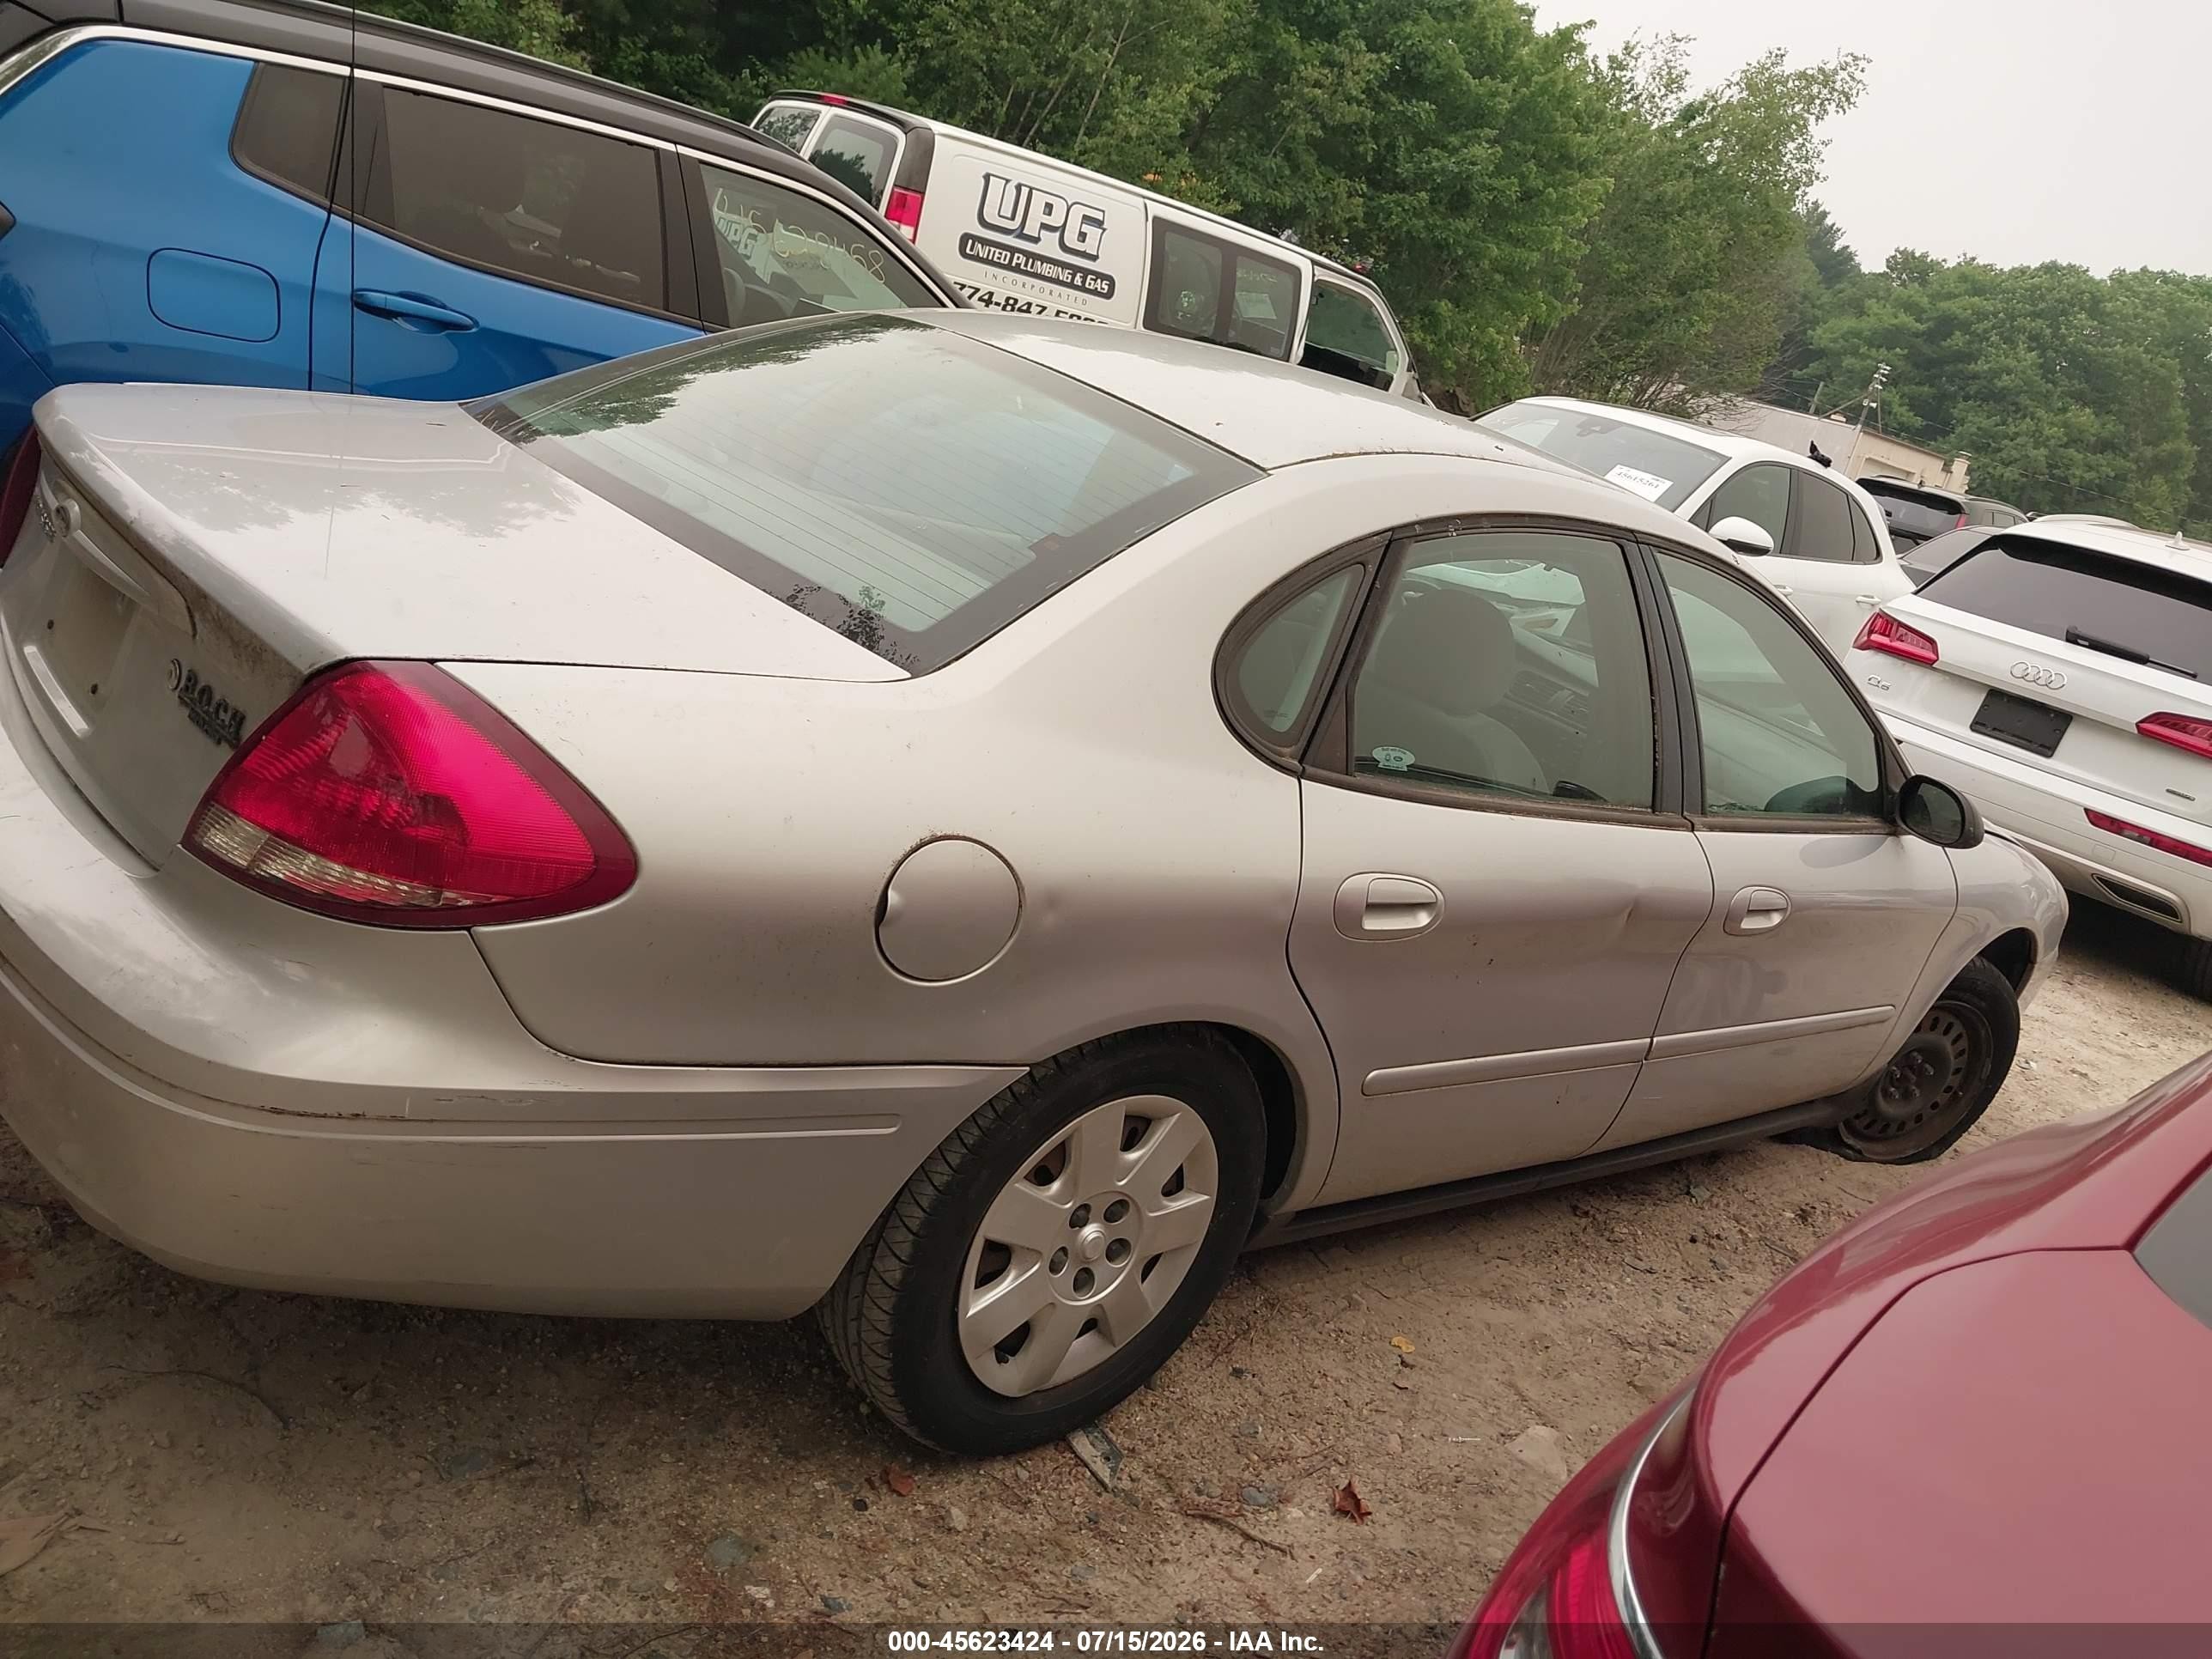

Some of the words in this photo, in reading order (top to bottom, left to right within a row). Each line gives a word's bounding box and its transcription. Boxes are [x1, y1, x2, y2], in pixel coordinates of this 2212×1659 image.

[977, 172, 1107, 263] UPG
[965, 239, 1011, 264] UNITED
[1012, 252, 1073, 283] PLUMBING
[1073, 272, 1084, 286] &
[1085, 274, 1110, 294] GAS
[984, 271, 1088, 306] INCORPORATED
